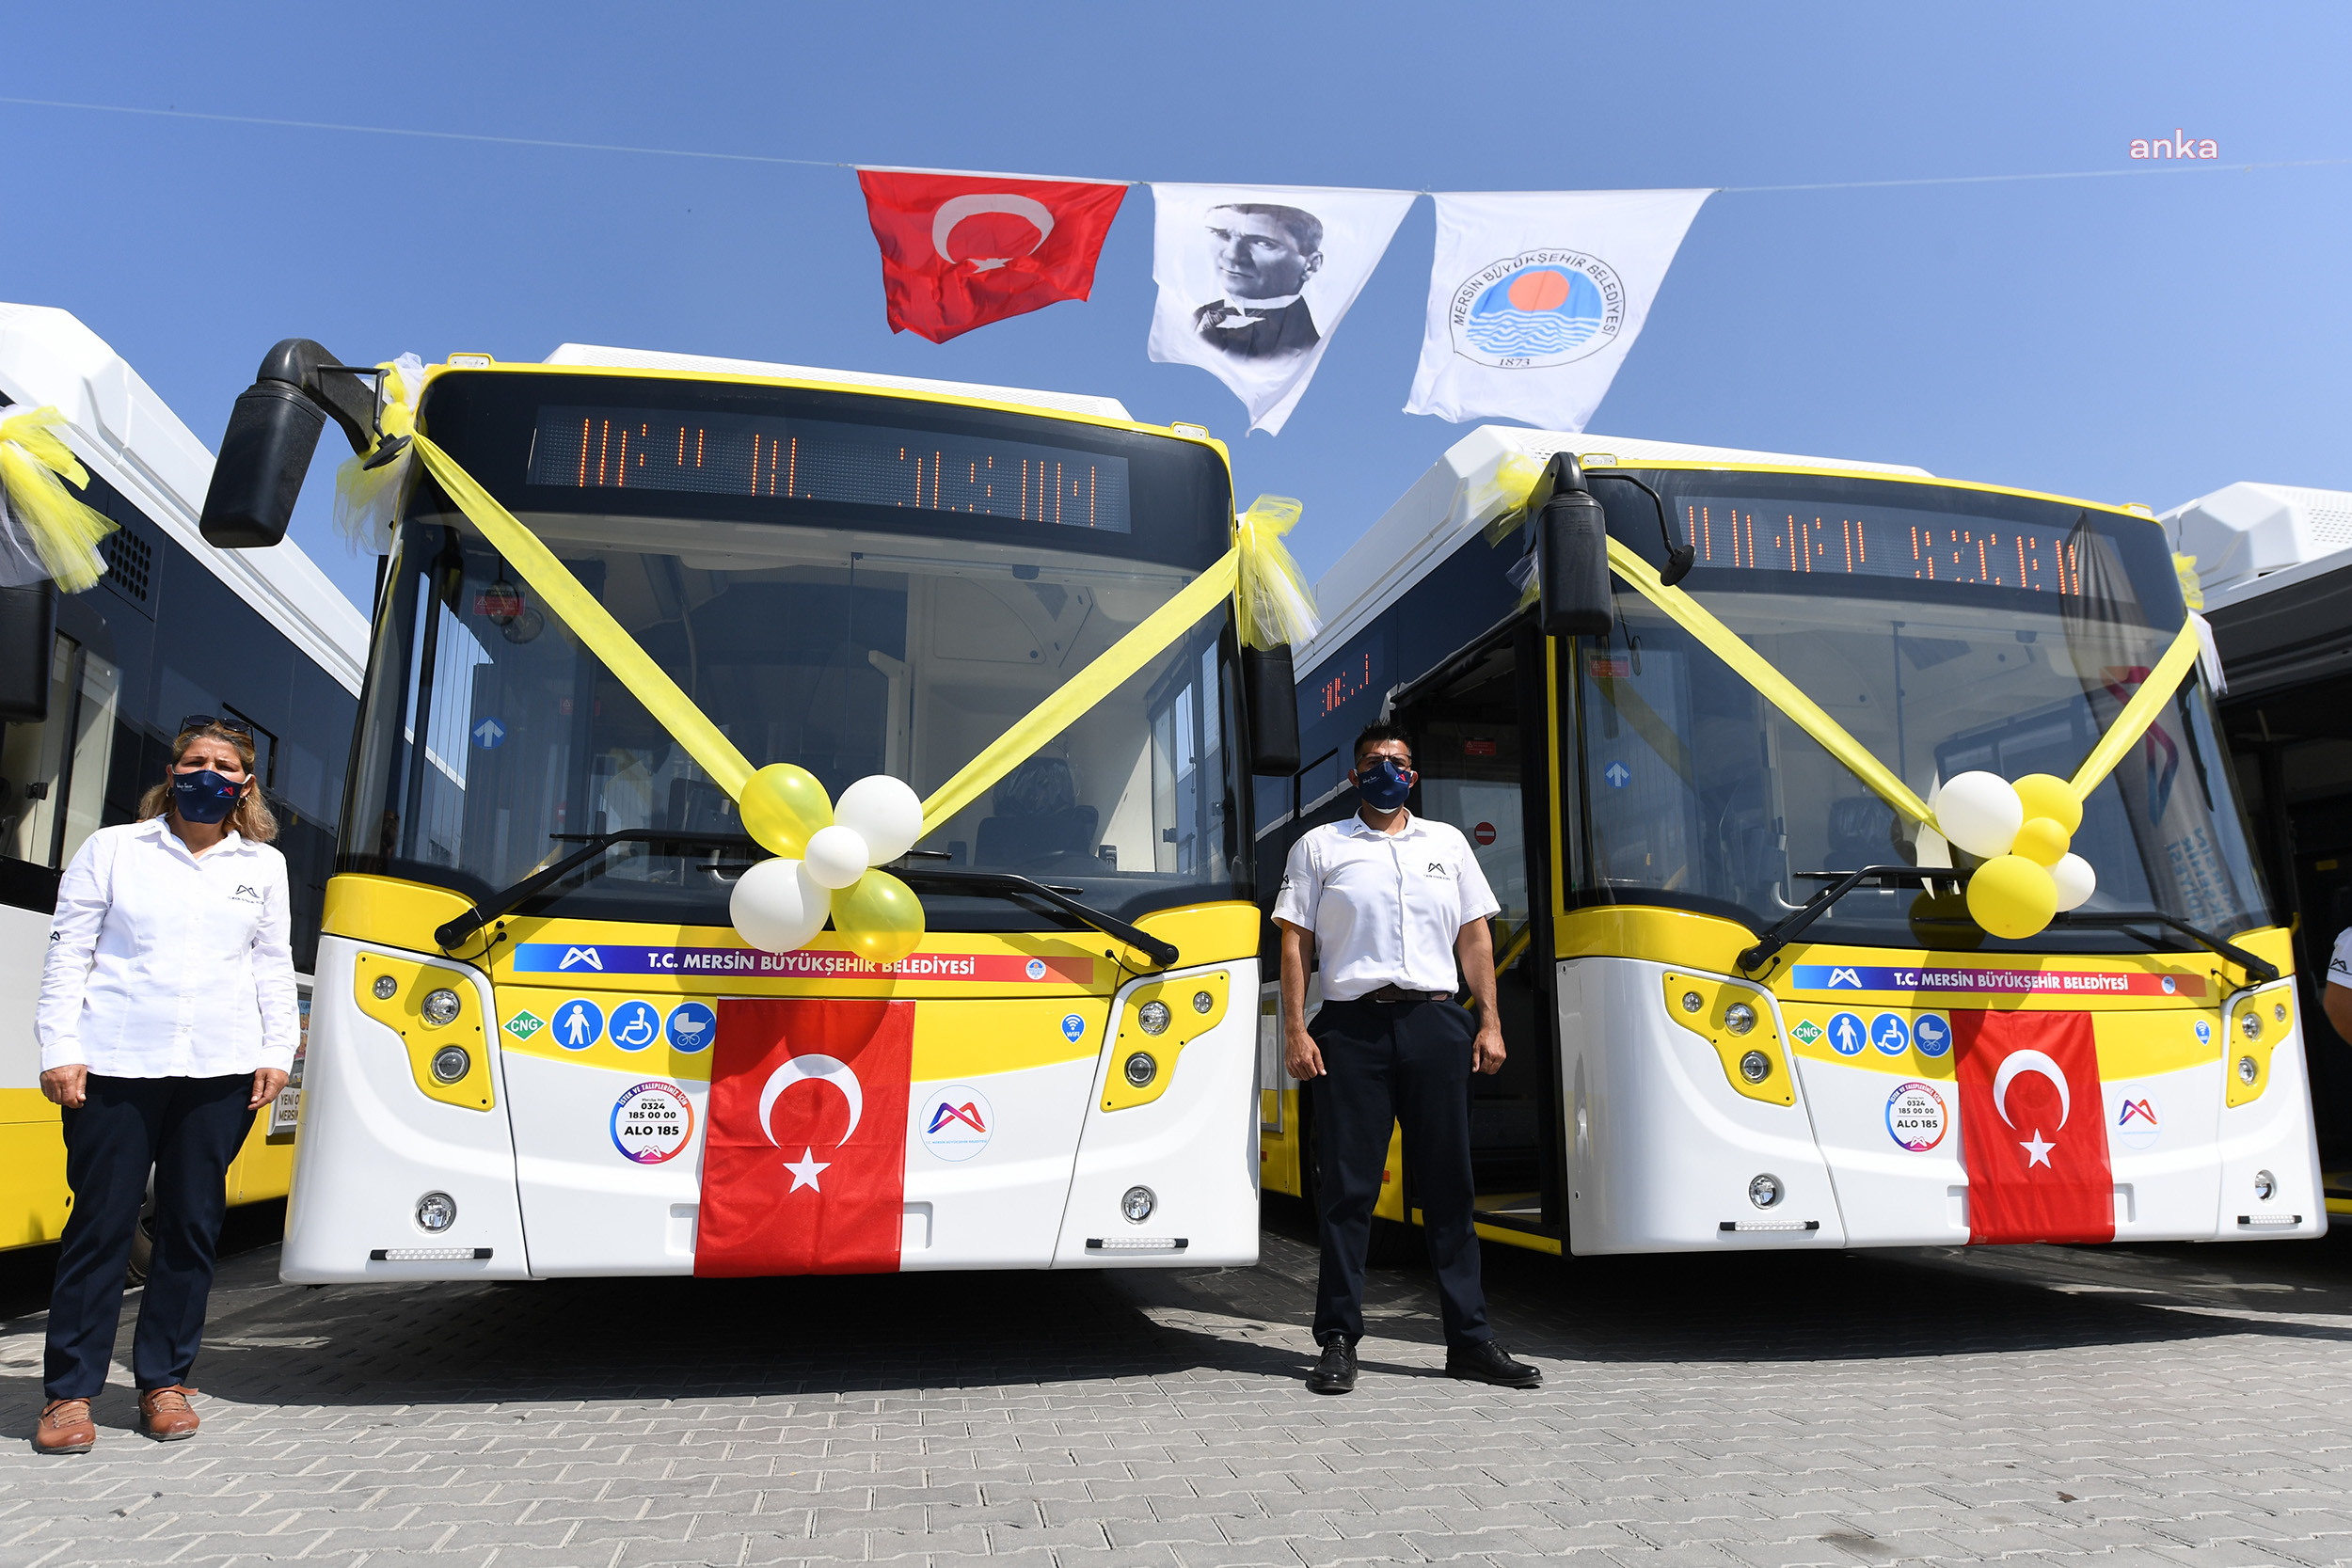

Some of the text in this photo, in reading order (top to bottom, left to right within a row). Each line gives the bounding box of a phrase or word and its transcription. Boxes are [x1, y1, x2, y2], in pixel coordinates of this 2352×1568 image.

[1454, 252, 1624, 337] MERSİN BÜYÜKŞEHİR BELEDİYESİ
[1499, 357, 1531, 367] 1873
[648, 952, 678, 968] T.C.
[683, 950, 755, 970] MERSİN
[882, 956, 976, 974] BELEDİYESİ
[1893, 971, 2128, 991] T.C. MERSİN BÜYÜKŞEHİR BELEDİYESİ
[510, 1019, 538, 1032] CNG
[1796, 1027, 1818, 1037] CNG
[624, 1126, 679, 1135] ALO 185
